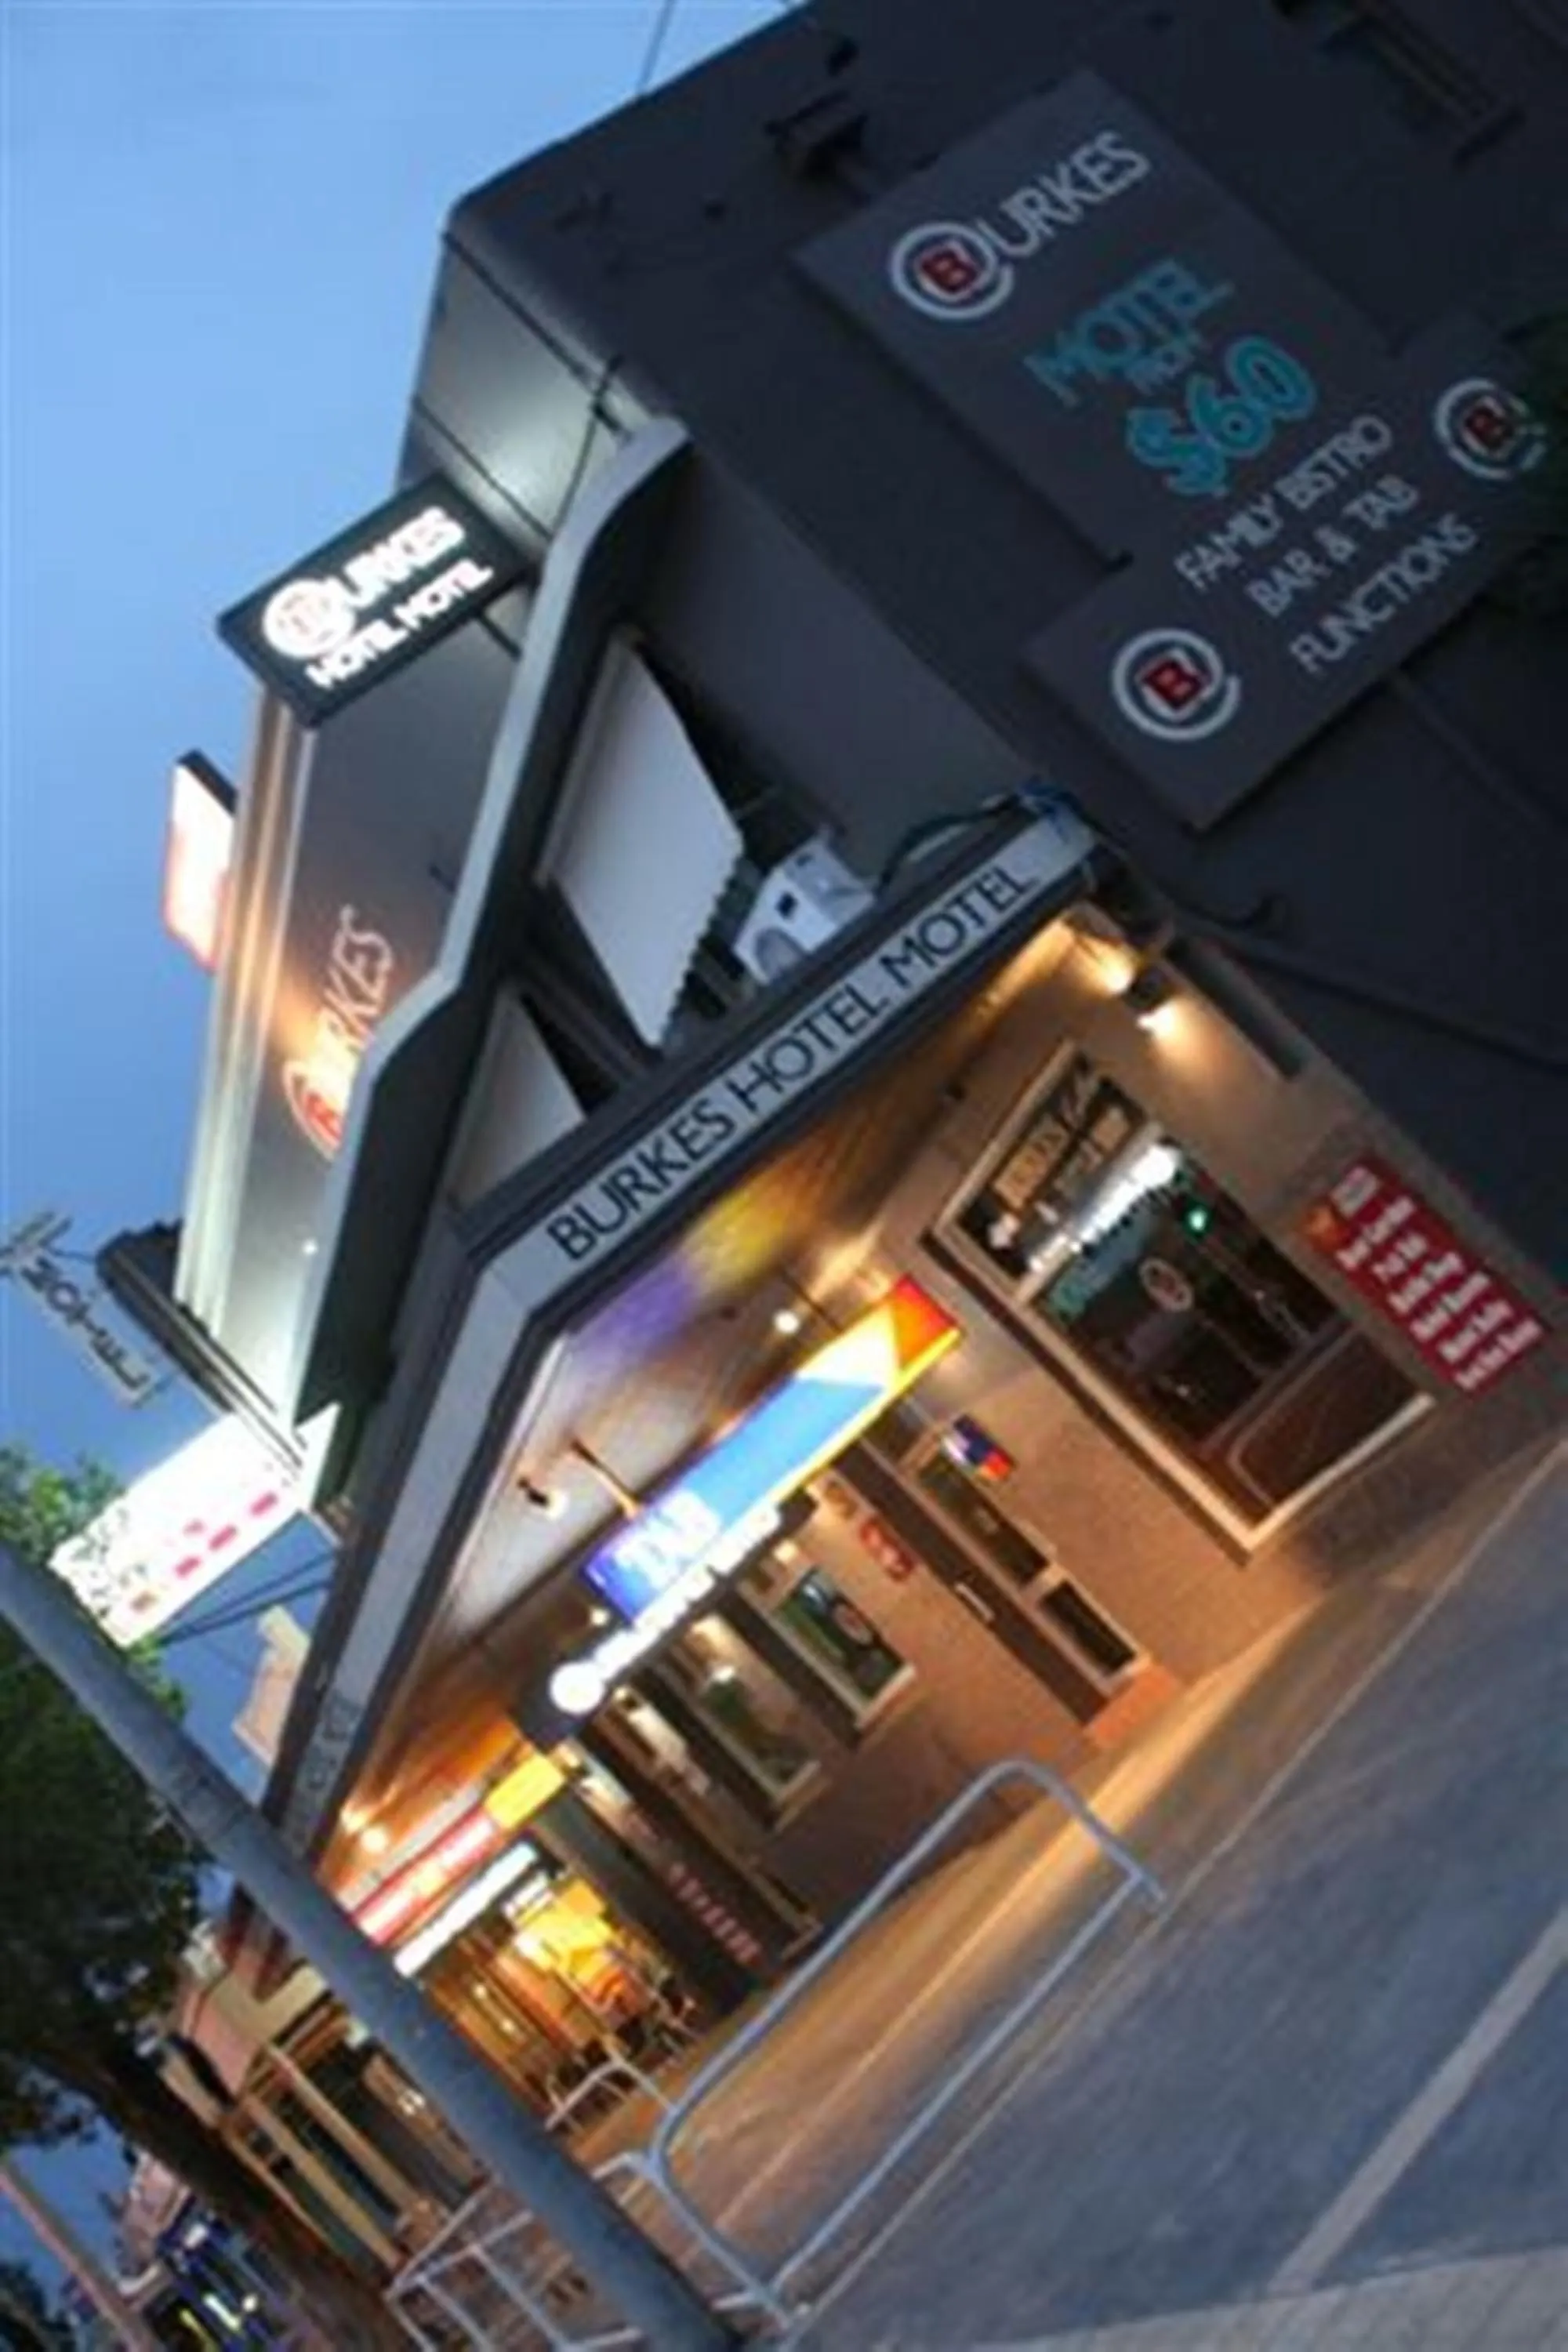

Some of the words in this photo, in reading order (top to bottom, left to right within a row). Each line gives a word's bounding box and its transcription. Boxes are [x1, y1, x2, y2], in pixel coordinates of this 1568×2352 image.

[1023, 260, 1233, 408] MOTEL
[1124, 336, 1319, 499] $60
[1174, 480, 1286, 591] FAMILY
[1278, 413, 1394, 517] BISTRO
[1246, 549, 1331, 619] BAR
[1316, 521, 1359, 564] &
[1345, 474, 1421, 539] TAB
[304, 619, 411, 691] HOTEL
[393, 558, 495, 630] MOTEL
[1290, 511, 1481, 677] FUNCTIONS
[545, 1095, 737, 1261] BURKES
[727, 985, 889, 1111] HOTEL
[878, 865, 1035, 988] MOTEL
[20, 1256, 151, 1390] MOTEL
